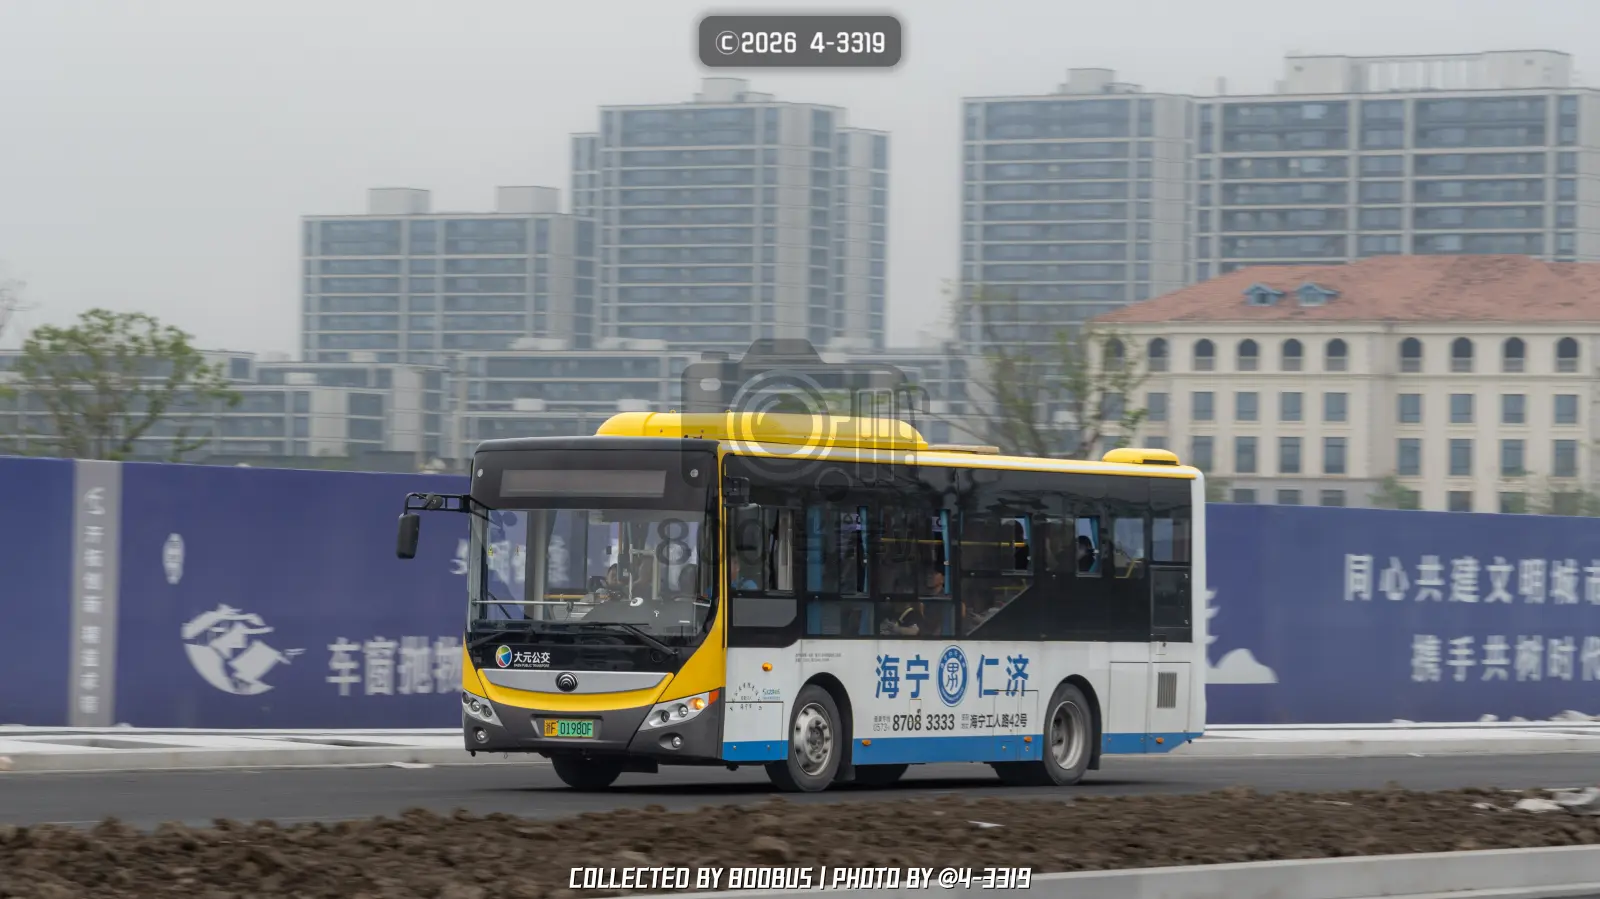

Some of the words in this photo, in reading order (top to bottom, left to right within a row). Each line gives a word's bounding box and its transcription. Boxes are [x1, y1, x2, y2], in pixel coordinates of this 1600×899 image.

[514, 652, 550, 663] 大元公交
[875, 654, 930, 698] 海宁
[976, 654, 1029, 698] 仁济
[560, 721, 593, 735] 01980F
[892, 714, 922, 731] 8708
[926, 713, 955, 731] 3333
[969, 713, 1028, 730] 海宁工人路42号
